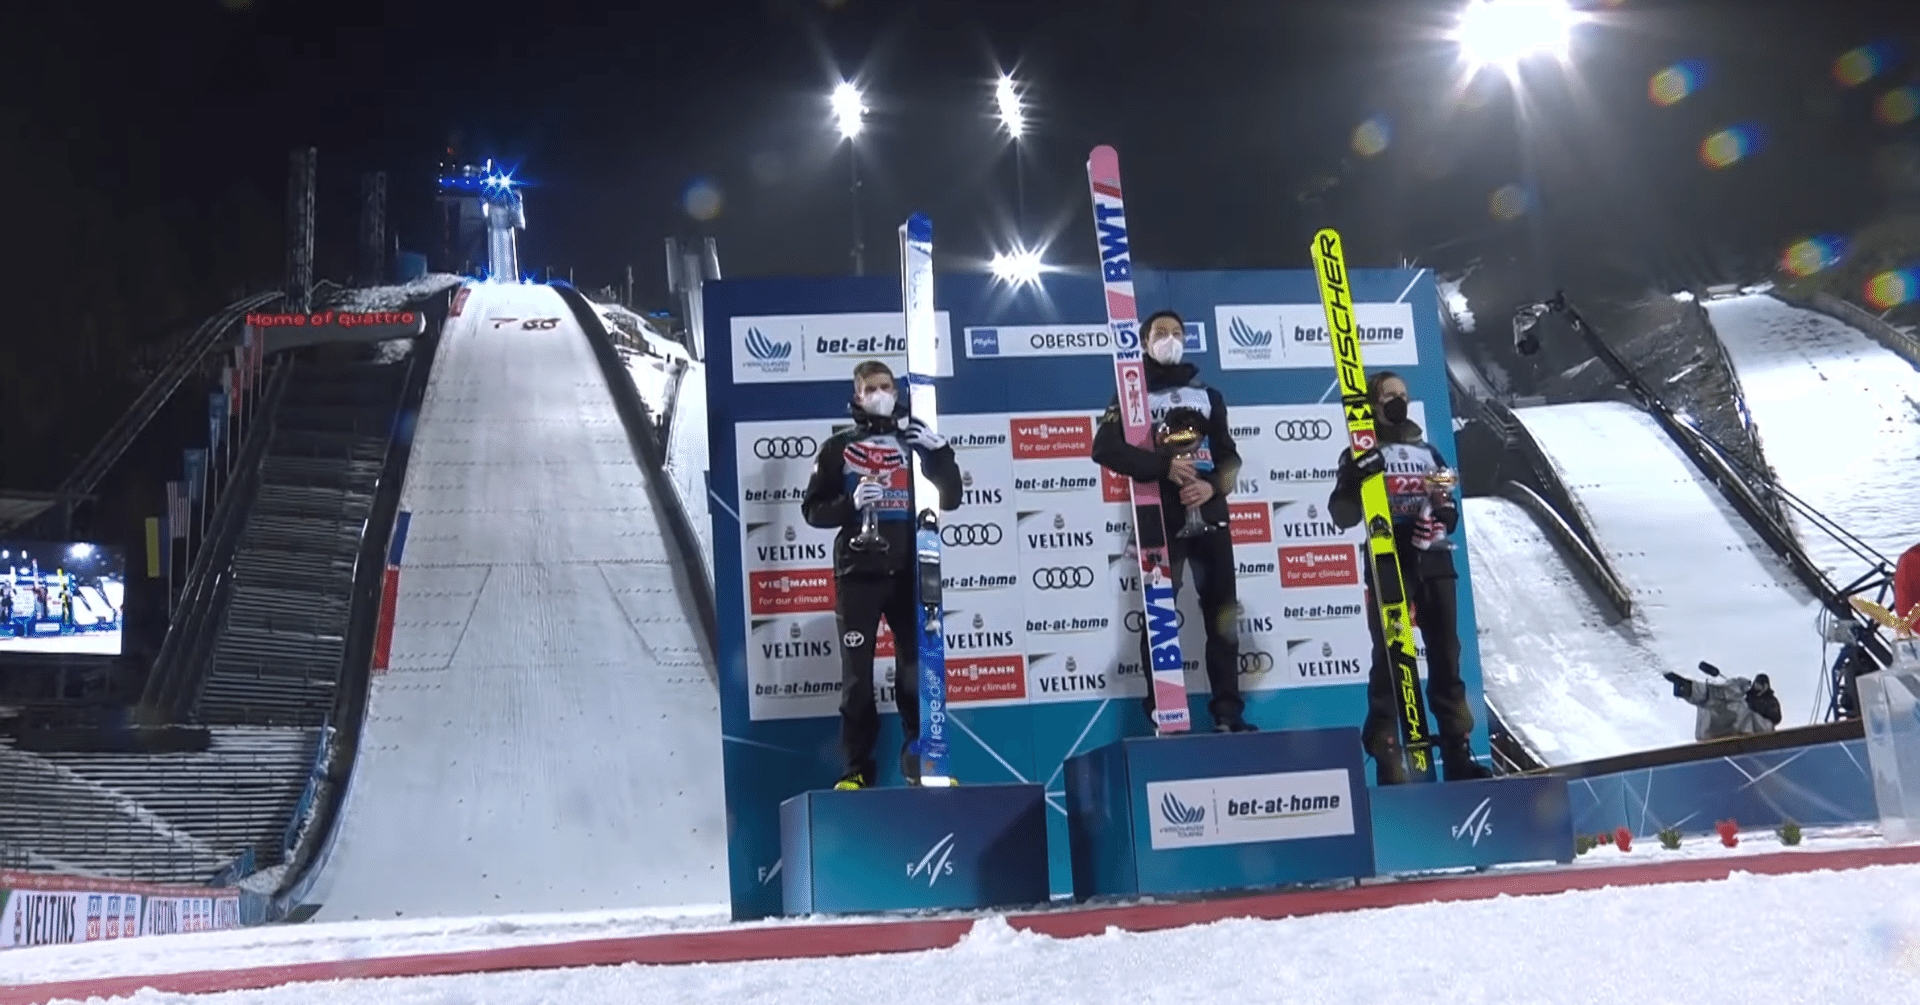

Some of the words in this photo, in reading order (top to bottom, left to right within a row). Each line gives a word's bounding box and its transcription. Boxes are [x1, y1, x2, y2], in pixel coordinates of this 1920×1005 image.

[1096, 202, 1133, 283] BWT
[246, 312, 306, 327] Home
[310, 308, 334, 325] of
[338, 311, 415, 328] quattro
[1319, 233, 1364, 394] FISCHER
[1030, 332, 1113, 349] OBERSTD
[1294, 324, 1404, 342] bet-home
[1035, 444, 1050, 452] our
[1052, 441, 1086, 450] climate
[1270, 468, 1339, 481] bet-at-hom
[1015, 477, 1096, 490] bet-at-home
[1395, 477, 1422, 494] 22
[960, 489, 1003, 505] TINS
[1028, 531, 1094, 549] VELTINS
[757, 544, 826, 561] VELTINS
[942, 574, 1017, 589] et-at-home
[1302, 571, 1316, 579] our
[1318, 569, 1351, 577] climate
[775, 597, 791, 605] our
[793, 595, 829, 604] climate
[1284, 604, 1361, 618] bet-at-home
[1026, 617, 1109, 632] bet-at-home
[1144, 583, 1183, 672] BWT
[1239, 616, 1273, 633] TINS
[946, 630, 1014, 649] VELTINS
[762, 641, 832, 659] VELTINS
[1297, 659, 1361, 677] VELTINS
[755, 681, 843, 695] bet-at-home
[964, 685, 981, 693] our
[982, 682, 1017, 691] climate
[1039, 674, 1106, 693] VELTINS
[1228, 793, 1341, 817] bet-at-home
[26, 894, 76, 944] VELTINS
